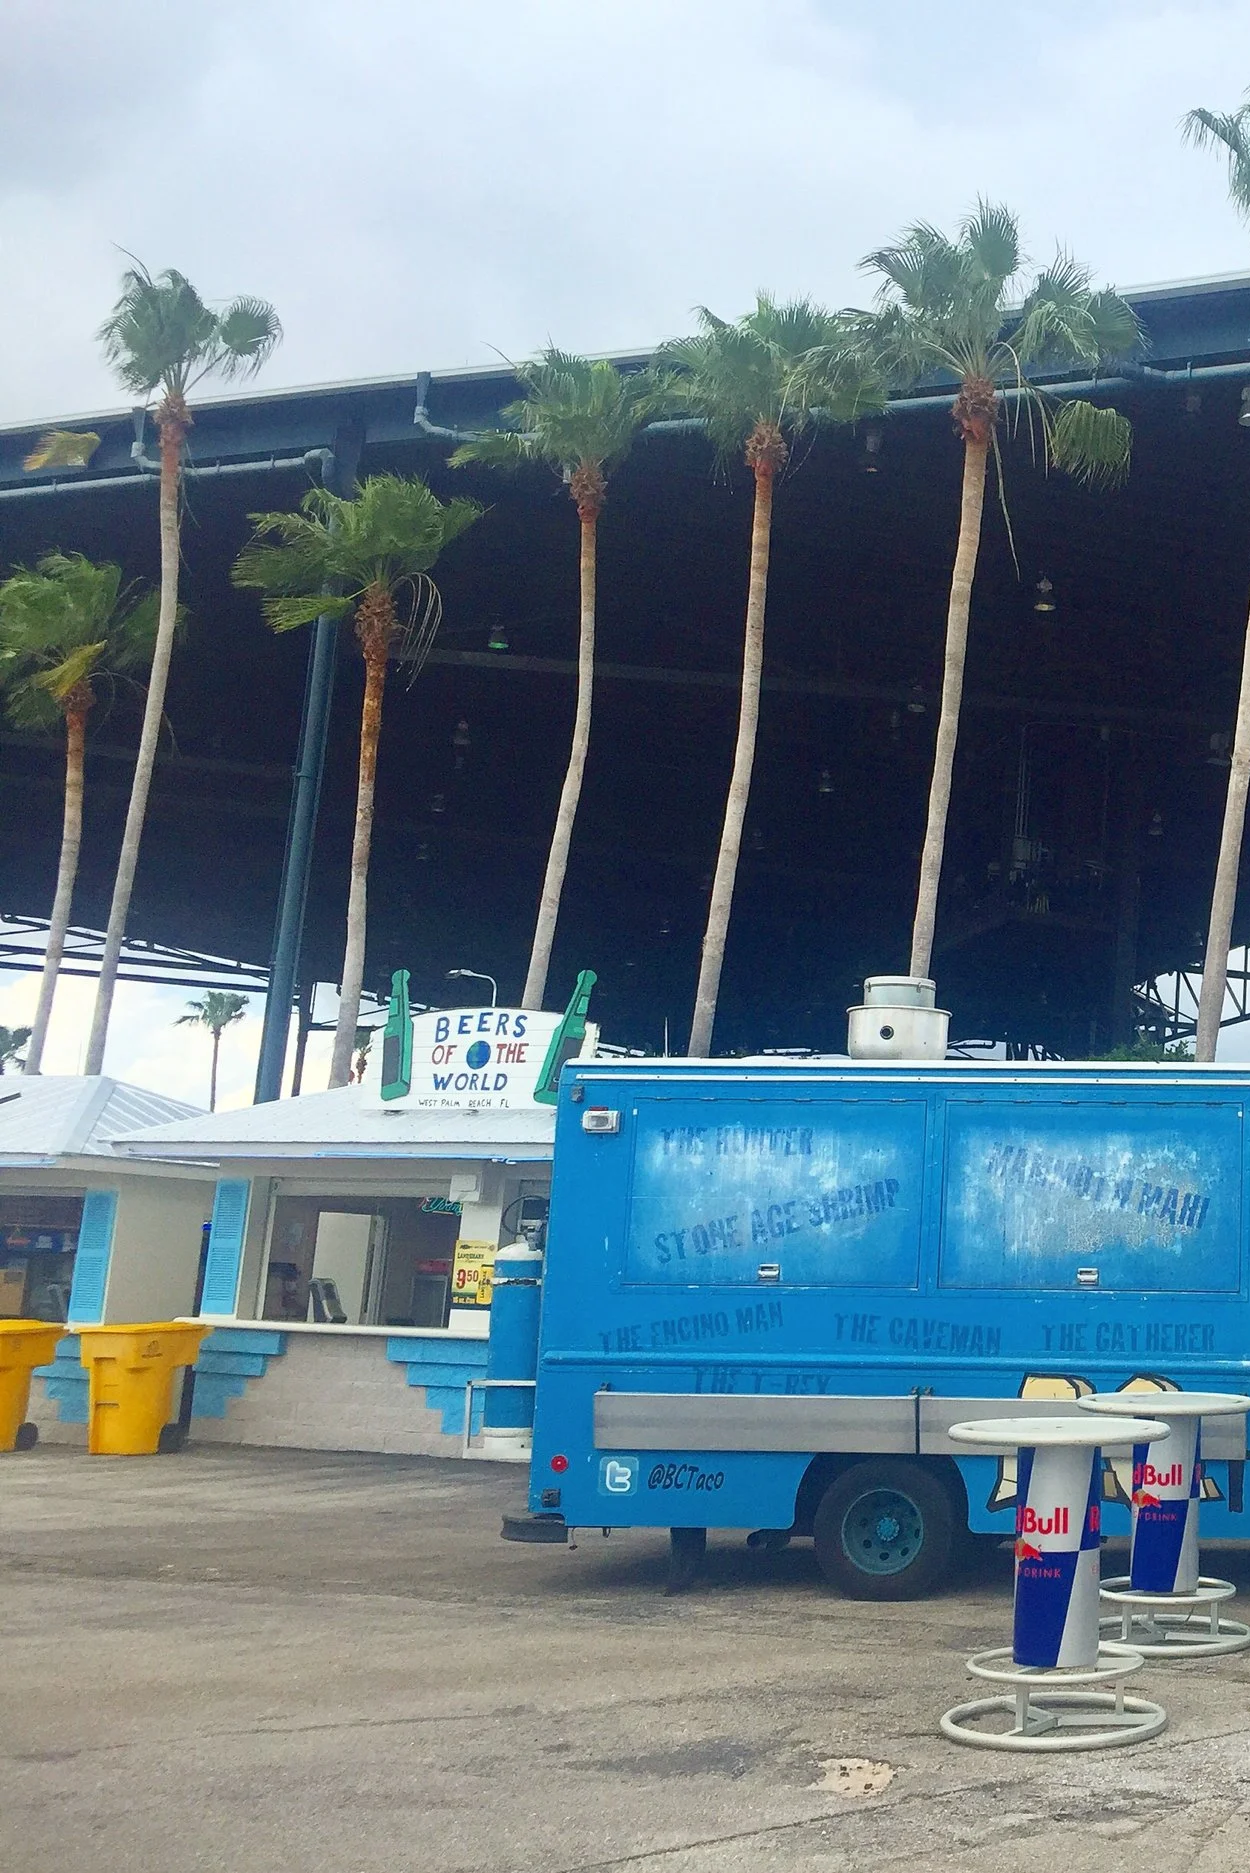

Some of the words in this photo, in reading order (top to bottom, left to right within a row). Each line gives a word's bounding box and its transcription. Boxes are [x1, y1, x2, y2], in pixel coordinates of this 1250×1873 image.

[435, 1012, 528, 1043] BEERS
[431, 1045, 457, 1065] OF
[496, 1043, 529, 1064] THE
[433, 1073, 508, 1091] WORLD
[419, 1099, 438, 1108] WEST
[441, 1099, 460, 1108] PALM
[500, 1099, 510, 1108] FL
[654, 1215, 739, 1265] STONE
[751, 1200, 801, 1244] AGE
[808, 1178, 901, 1227] SHRIMP
[598, 1325, 643, 1354] THE
[650, 1311, 730, 1347] ENCINO
[735, 1301, 784, 1334] MAN
[834, 1312, 882, 1344] THE
[889, 1316, 1001, 1356] CAVEMAN
[1041, 1323, 1088, 1351] THE
[1095, 1321, 1216, 1351] GATHERER
[694, 1366, 738, 1394] THE
[648, 1463, 725, 1491] @BCTaco
[1143, 1464, 1183, 1486] Bull
[1024, 1507, 1069, 1534] Bull
[1145, 1512, 1177, 1521] DRINK
[1024, 1567, 1061, 1578] DRINK
